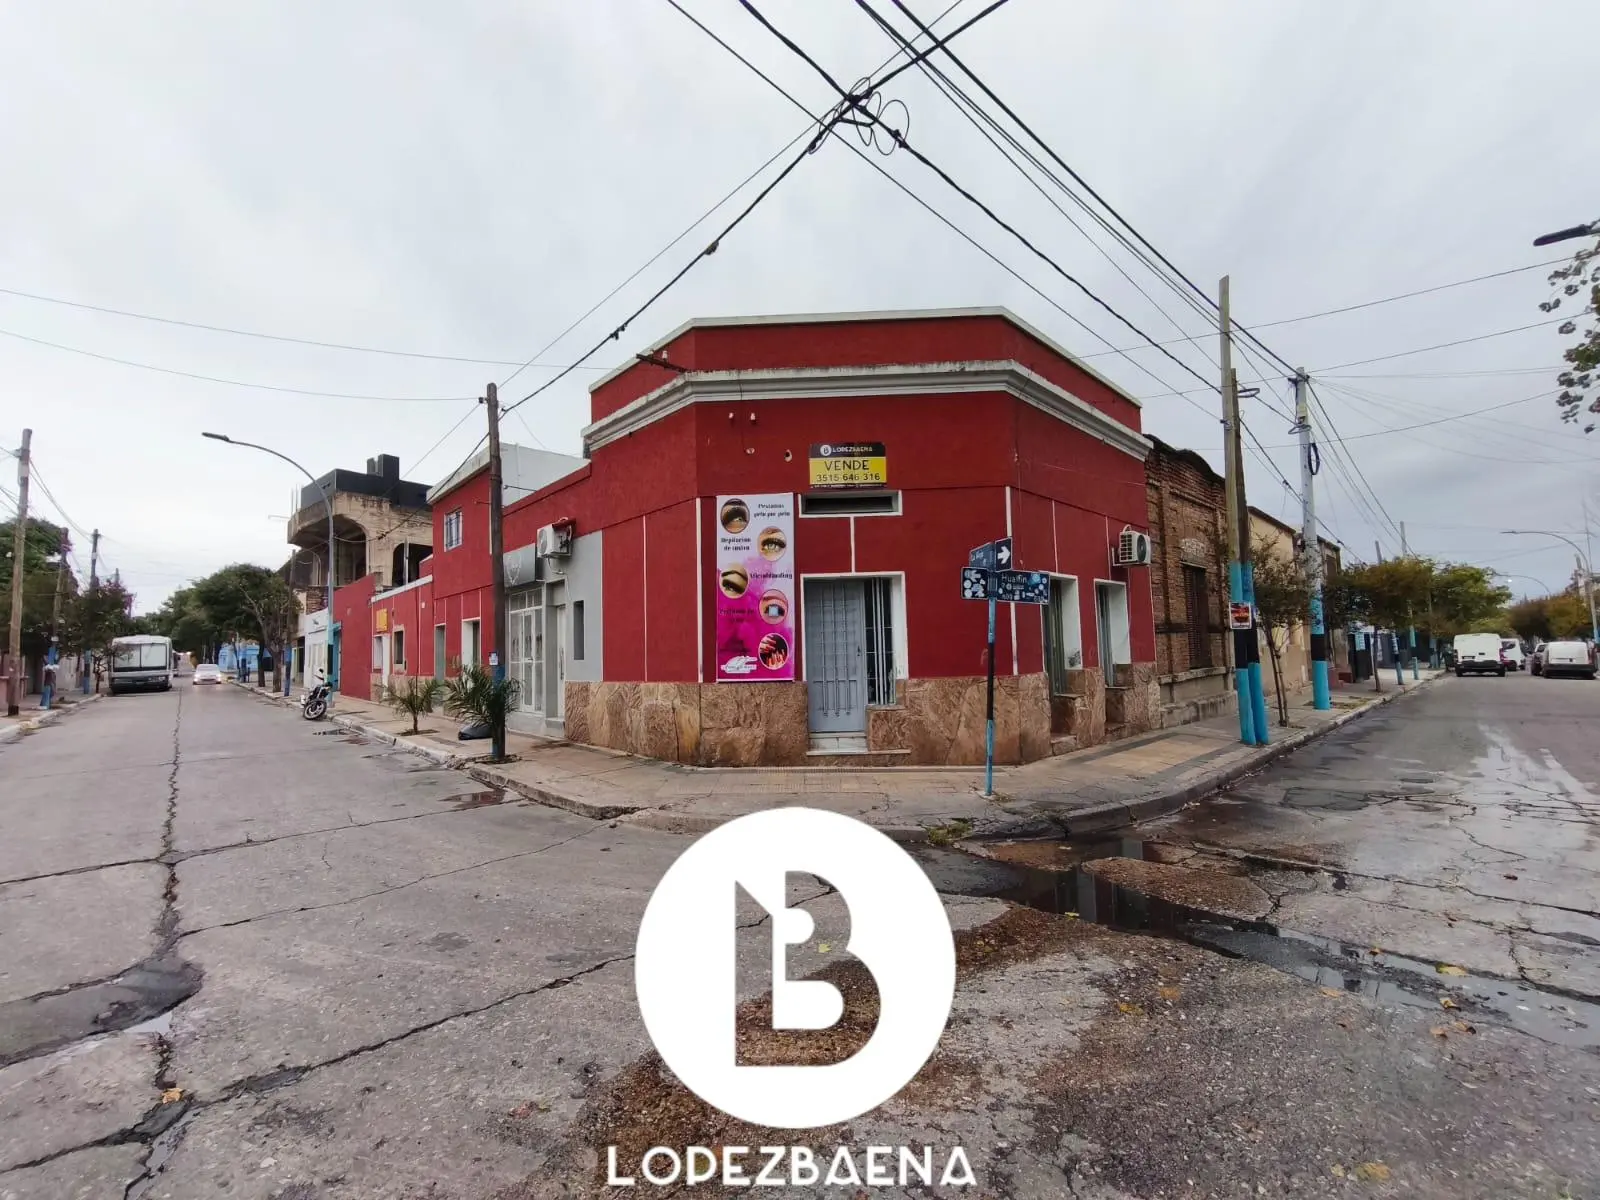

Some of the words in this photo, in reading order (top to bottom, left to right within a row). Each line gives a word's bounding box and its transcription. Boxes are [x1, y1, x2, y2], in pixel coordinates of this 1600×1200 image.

[824, 460, 870, 471] VENDE
[816, 474, 840, 482] 3515
[842, 473, 860, 481] 646
[863, 472, 881, 481] 316
